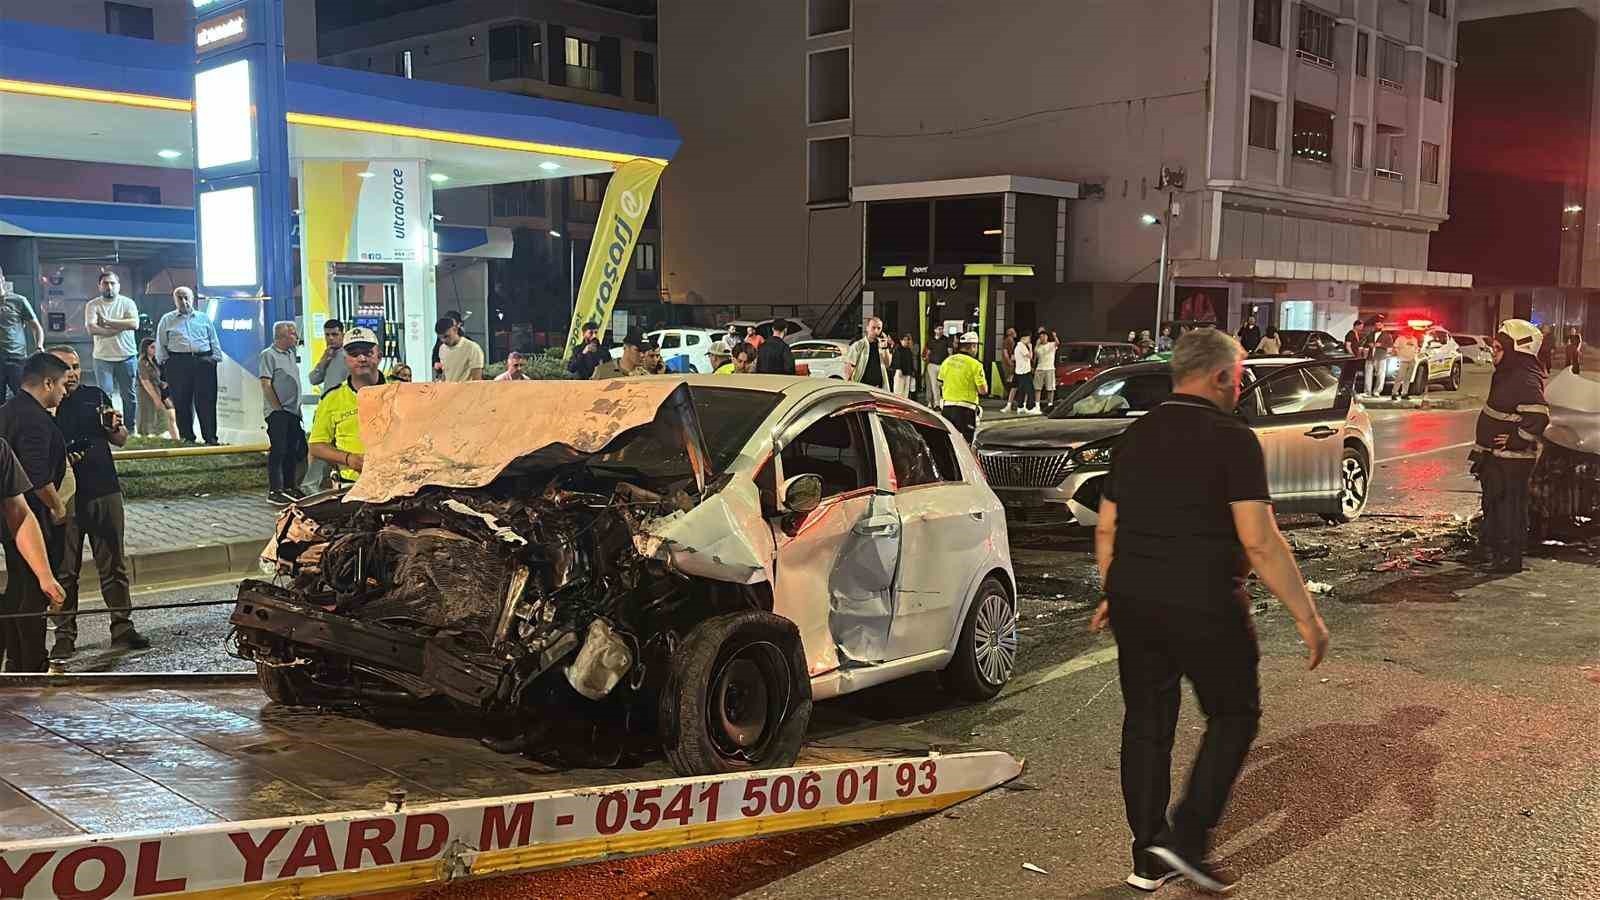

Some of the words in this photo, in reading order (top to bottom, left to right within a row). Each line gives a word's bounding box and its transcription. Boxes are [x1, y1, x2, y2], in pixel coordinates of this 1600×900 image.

[392, 167, 406, 239] ultraforce
[0, 841, 187, 900] YOL
[228, 812, 450, 882] YARD
[479, 801, 535, 852] M
[595, 782, 719, 835] 0541
[741, 771, 822, 817] 506
[836, 765, 879, 806] 01
[896, 760, 937, 797] 93
